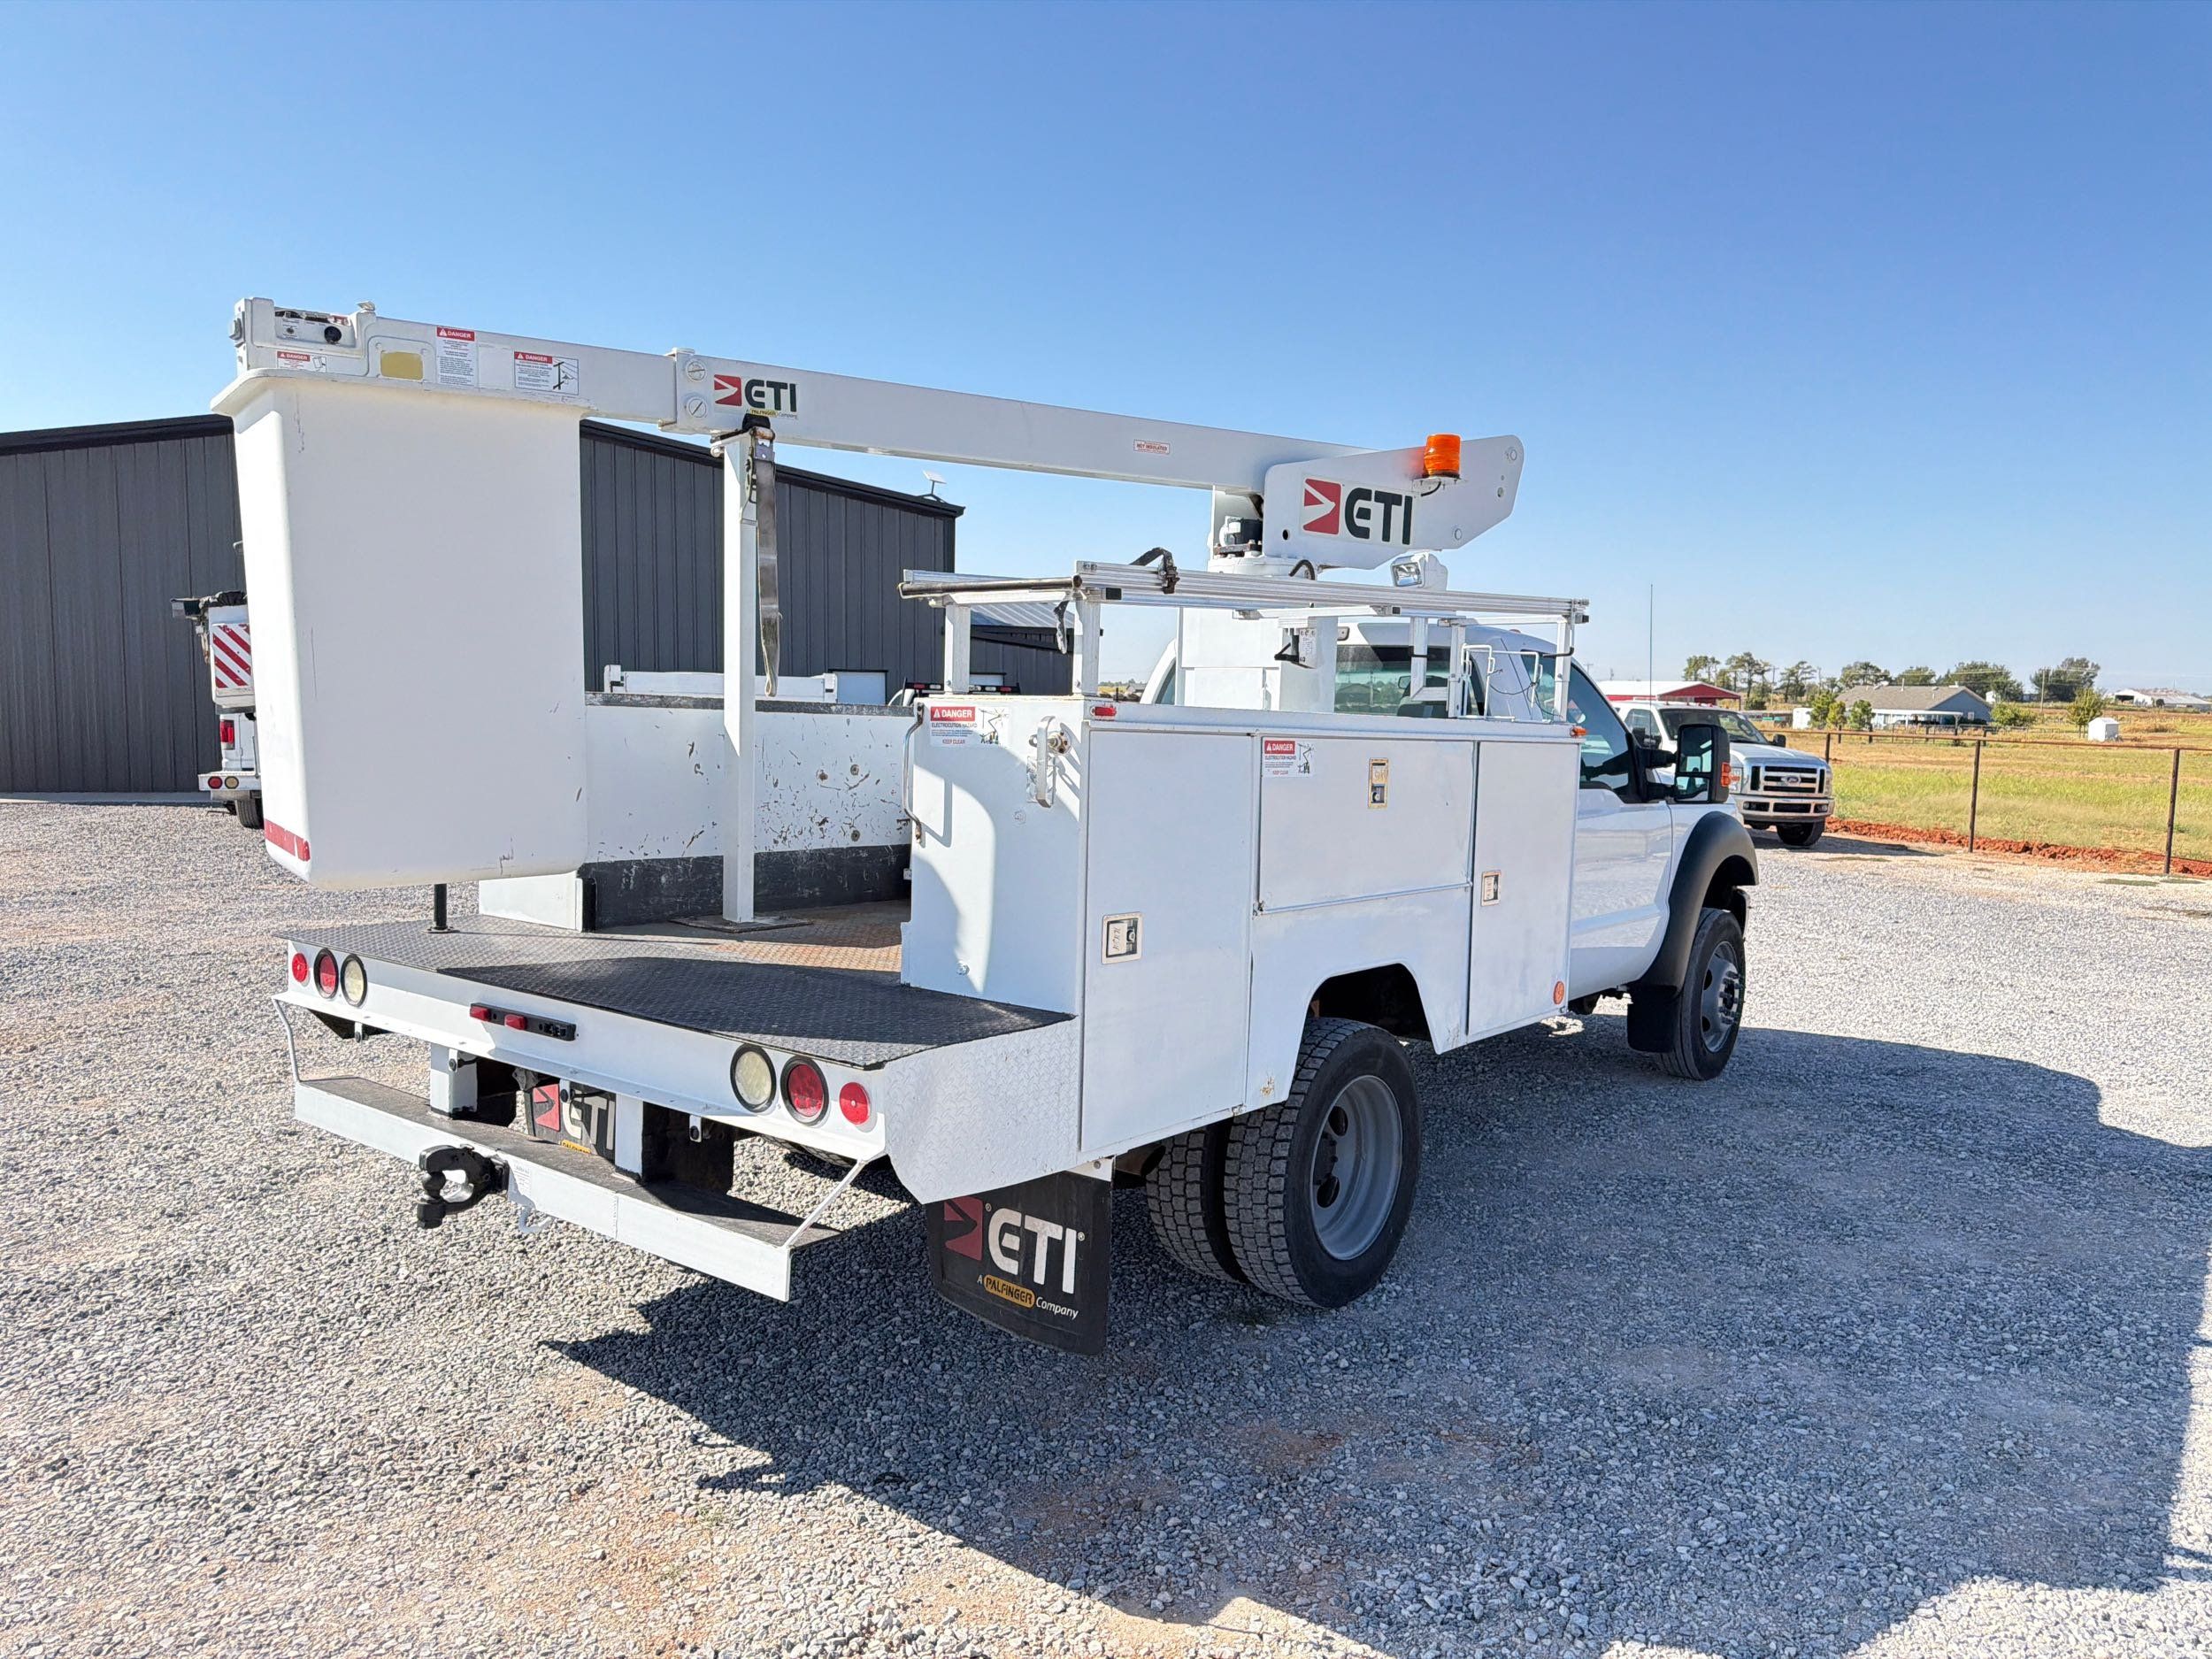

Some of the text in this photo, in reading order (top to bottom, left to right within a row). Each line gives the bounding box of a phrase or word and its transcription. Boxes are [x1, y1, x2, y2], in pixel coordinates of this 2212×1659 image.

[447, 330, 472, 339] DANGER
[745, 379, 797, 412] ETI
[1345, 488, 1413, 545] ETI
[941, 709, 972, 718] DANGER
[988, 1208, 1077, 1294] ETI
[977, 1275, 1079, 1320] A PALFINGER Company
